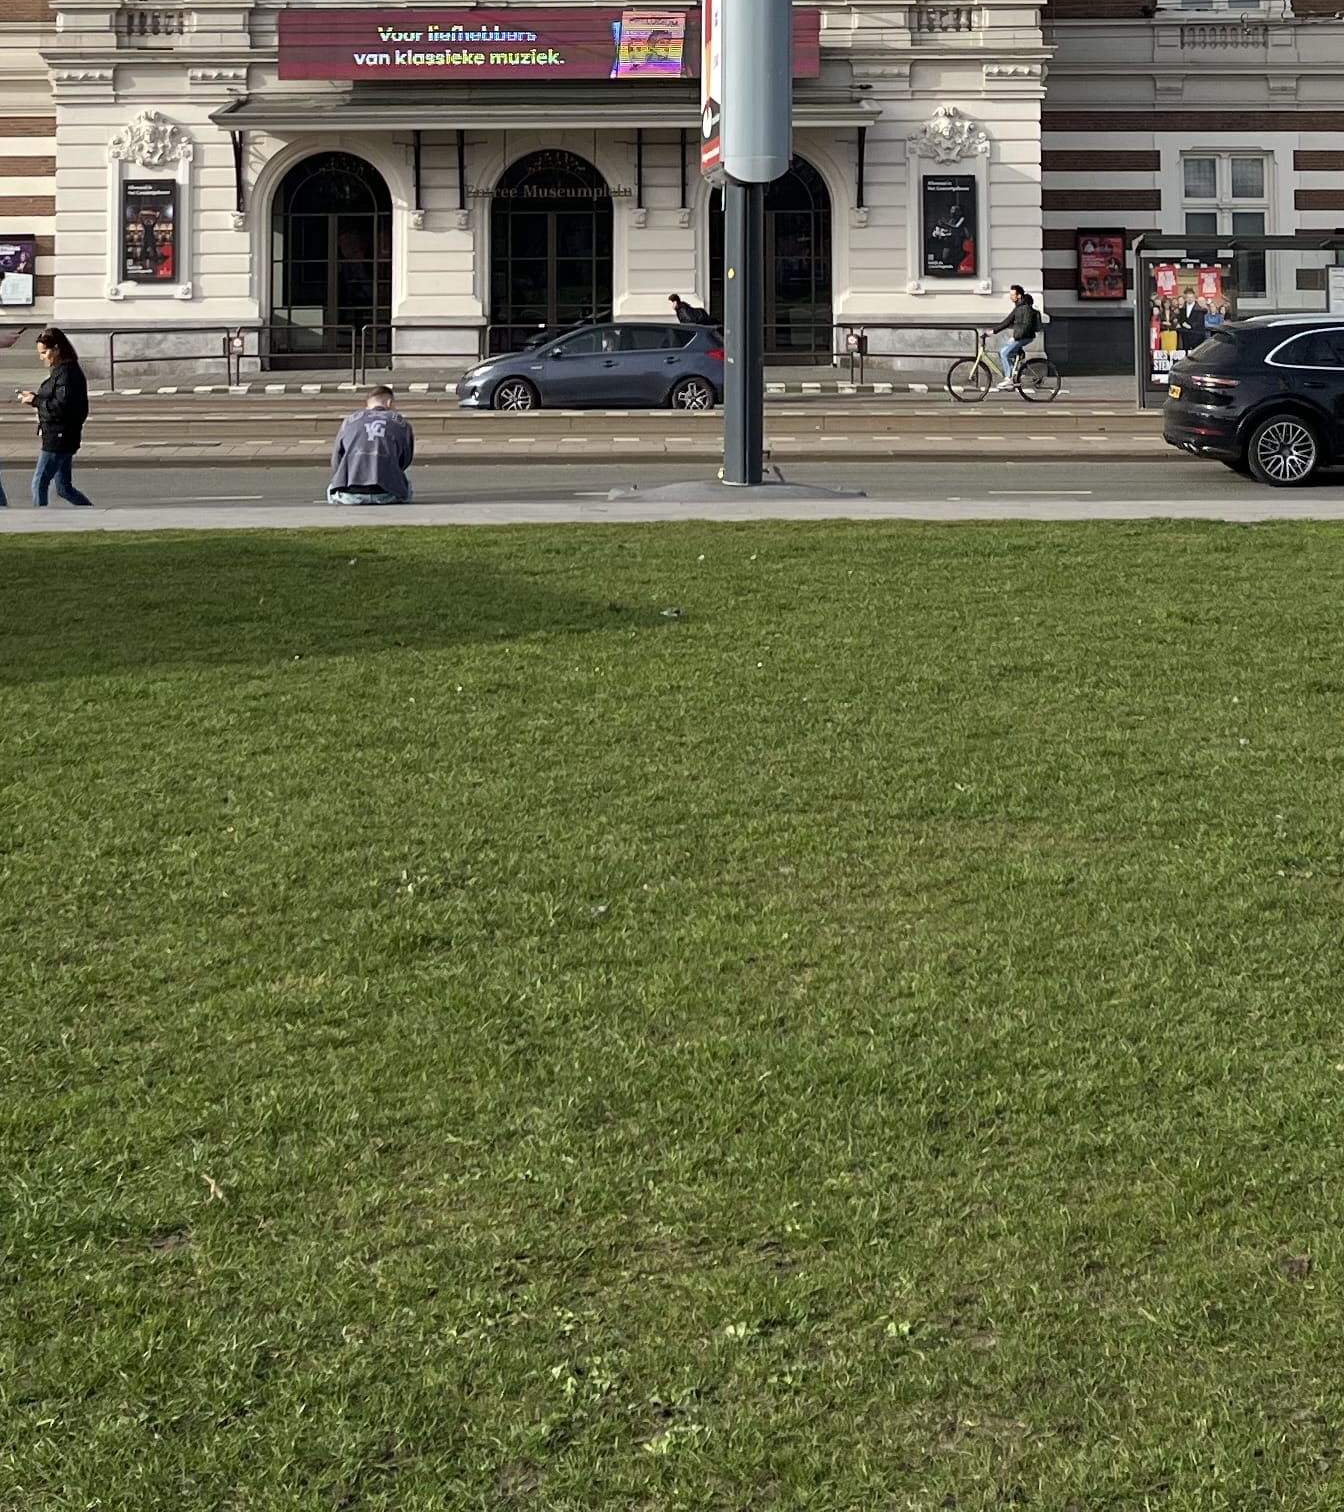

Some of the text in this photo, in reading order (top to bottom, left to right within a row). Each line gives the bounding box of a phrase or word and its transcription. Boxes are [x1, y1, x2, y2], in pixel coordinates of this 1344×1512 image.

[353, 49, 565, 65] van klassieke muziek.
